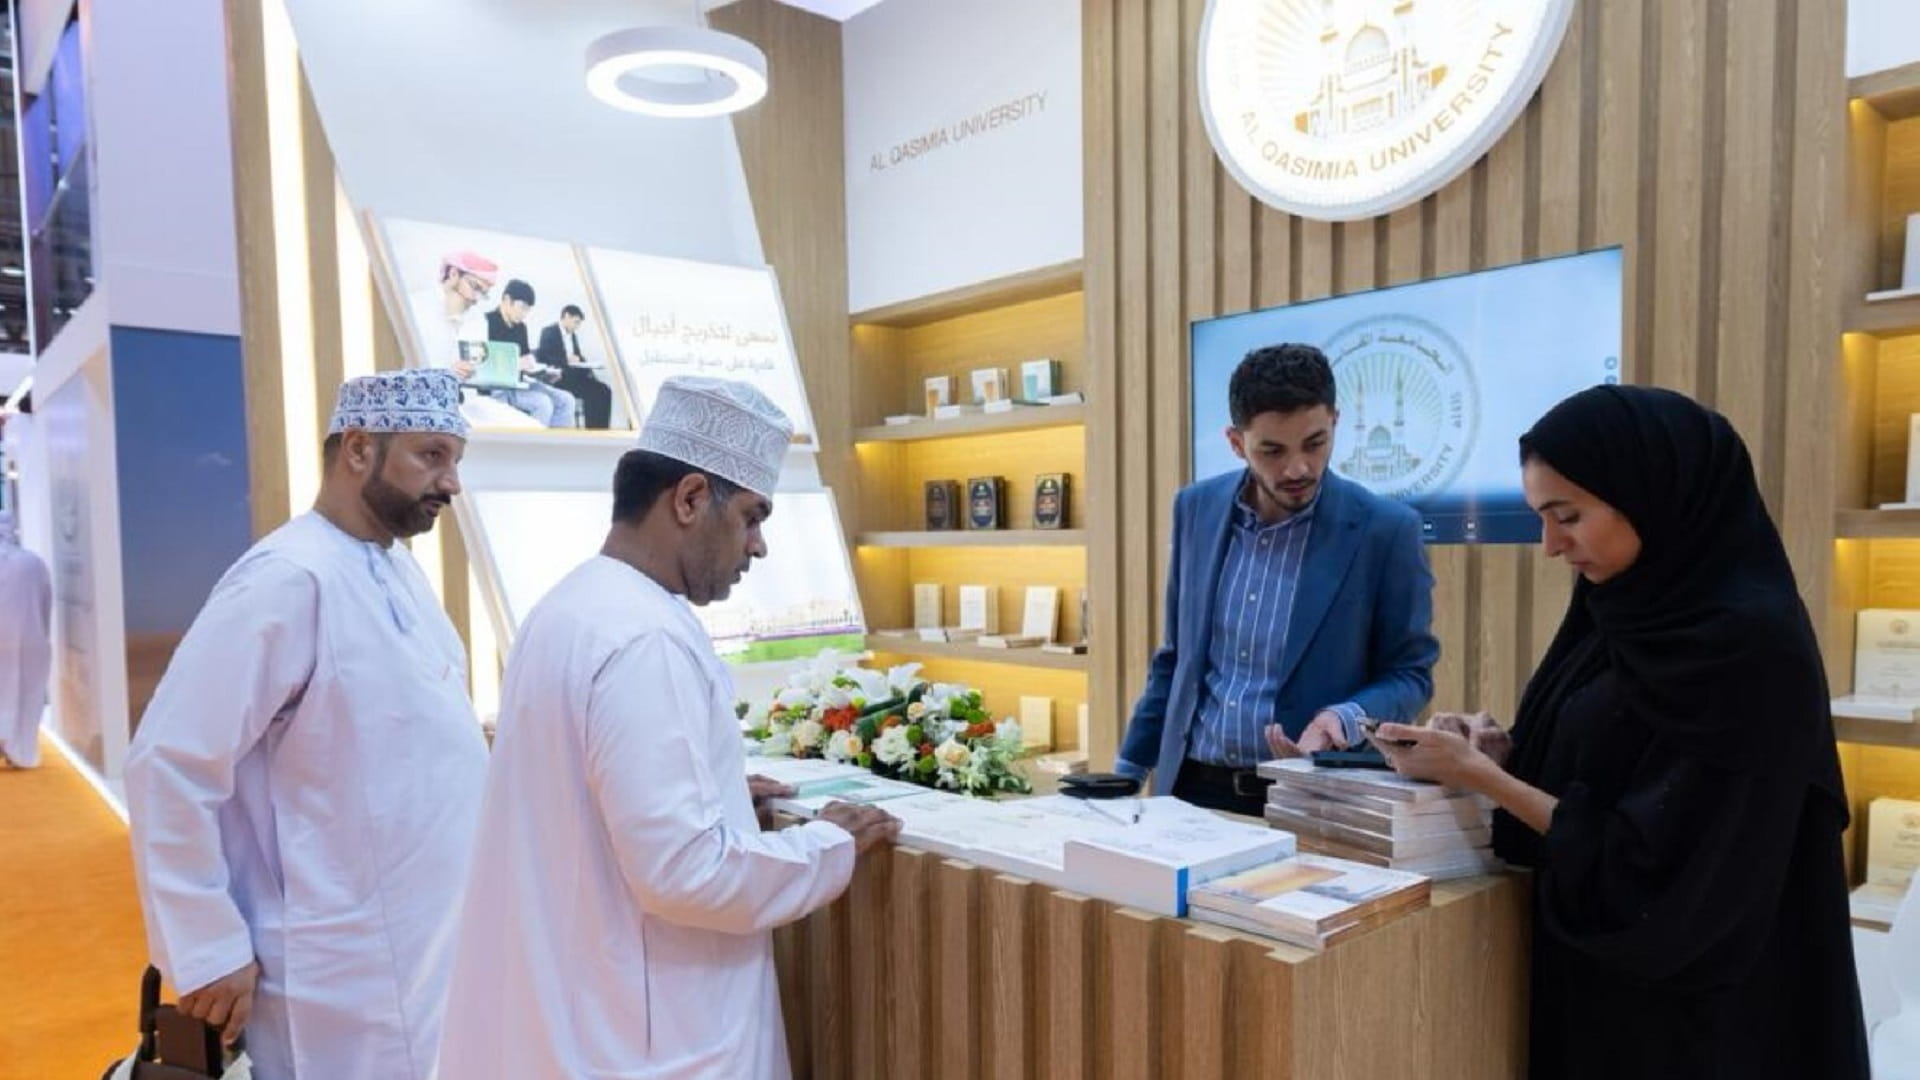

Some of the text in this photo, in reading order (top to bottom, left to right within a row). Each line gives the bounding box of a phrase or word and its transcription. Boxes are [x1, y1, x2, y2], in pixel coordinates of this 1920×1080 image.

[870, 91, 1047, 172] AL QASIMIA UNIVERSITY
[1240, 21, 1514, 181] AL QASIMIA UNIVERSITY
[1390, 445, 1453, 501] NIVERSITY
